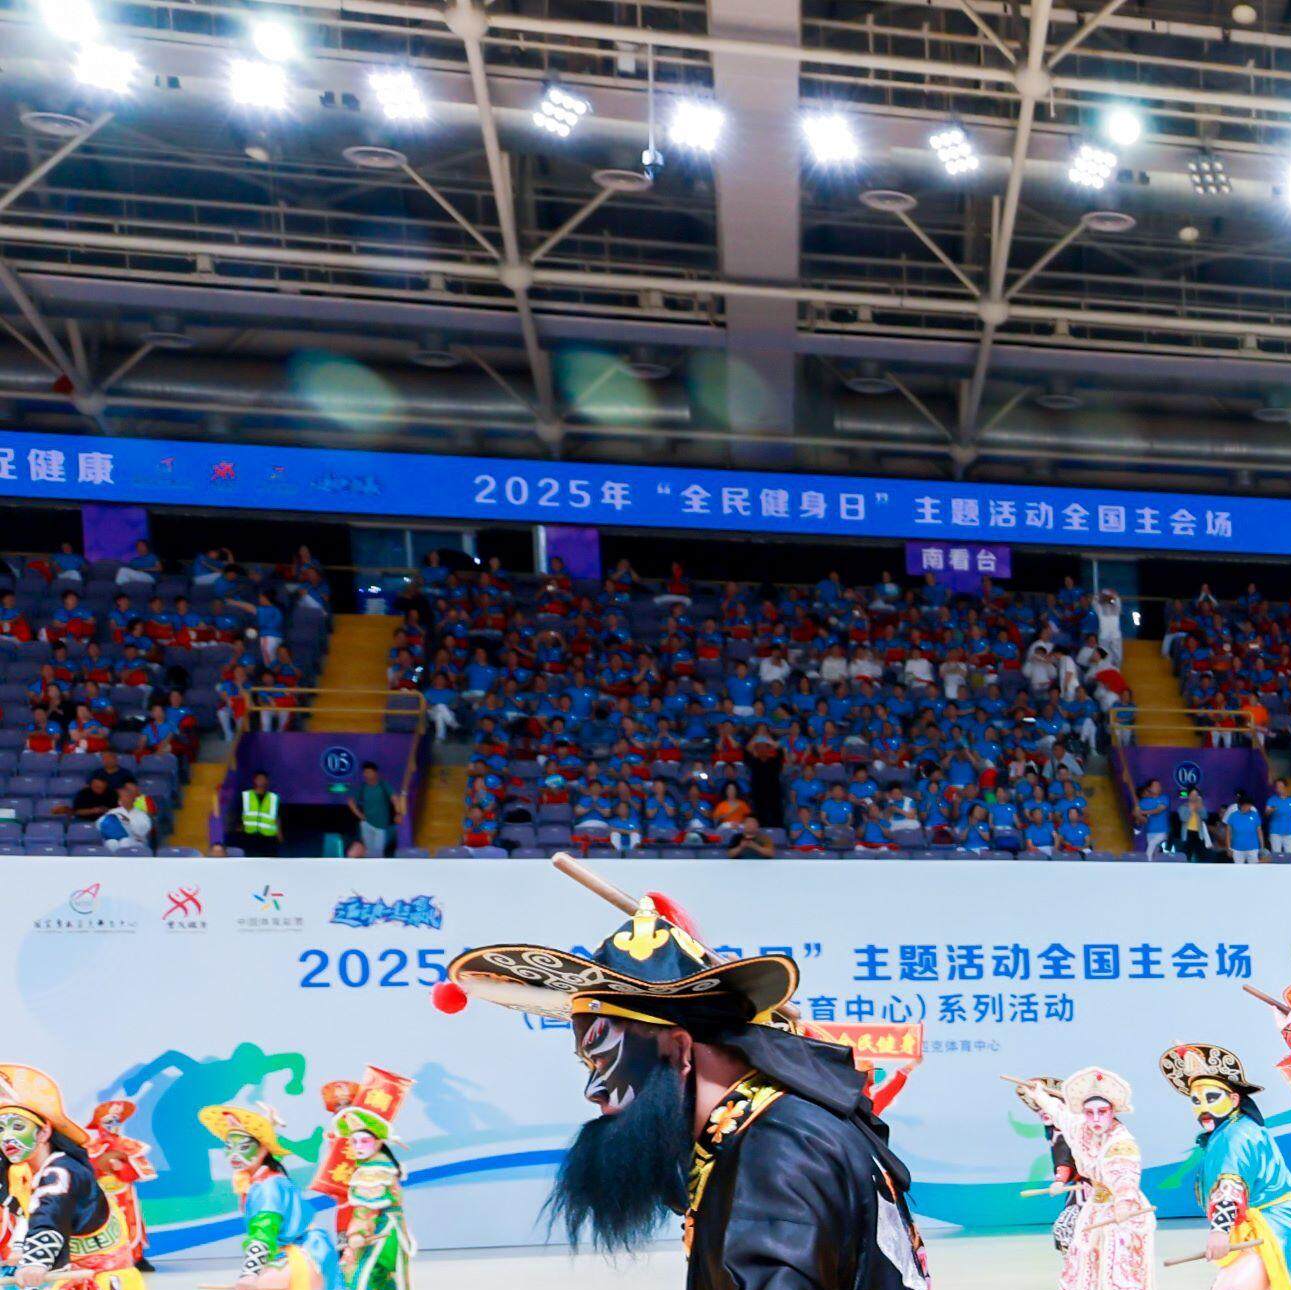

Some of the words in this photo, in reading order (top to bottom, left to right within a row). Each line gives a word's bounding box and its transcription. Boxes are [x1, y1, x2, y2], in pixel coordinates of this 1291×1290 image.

[921, 547, 998, 572] 南看台
[327, 753, 350, 772] 05
[1177, 767, 1196, 783] 06
